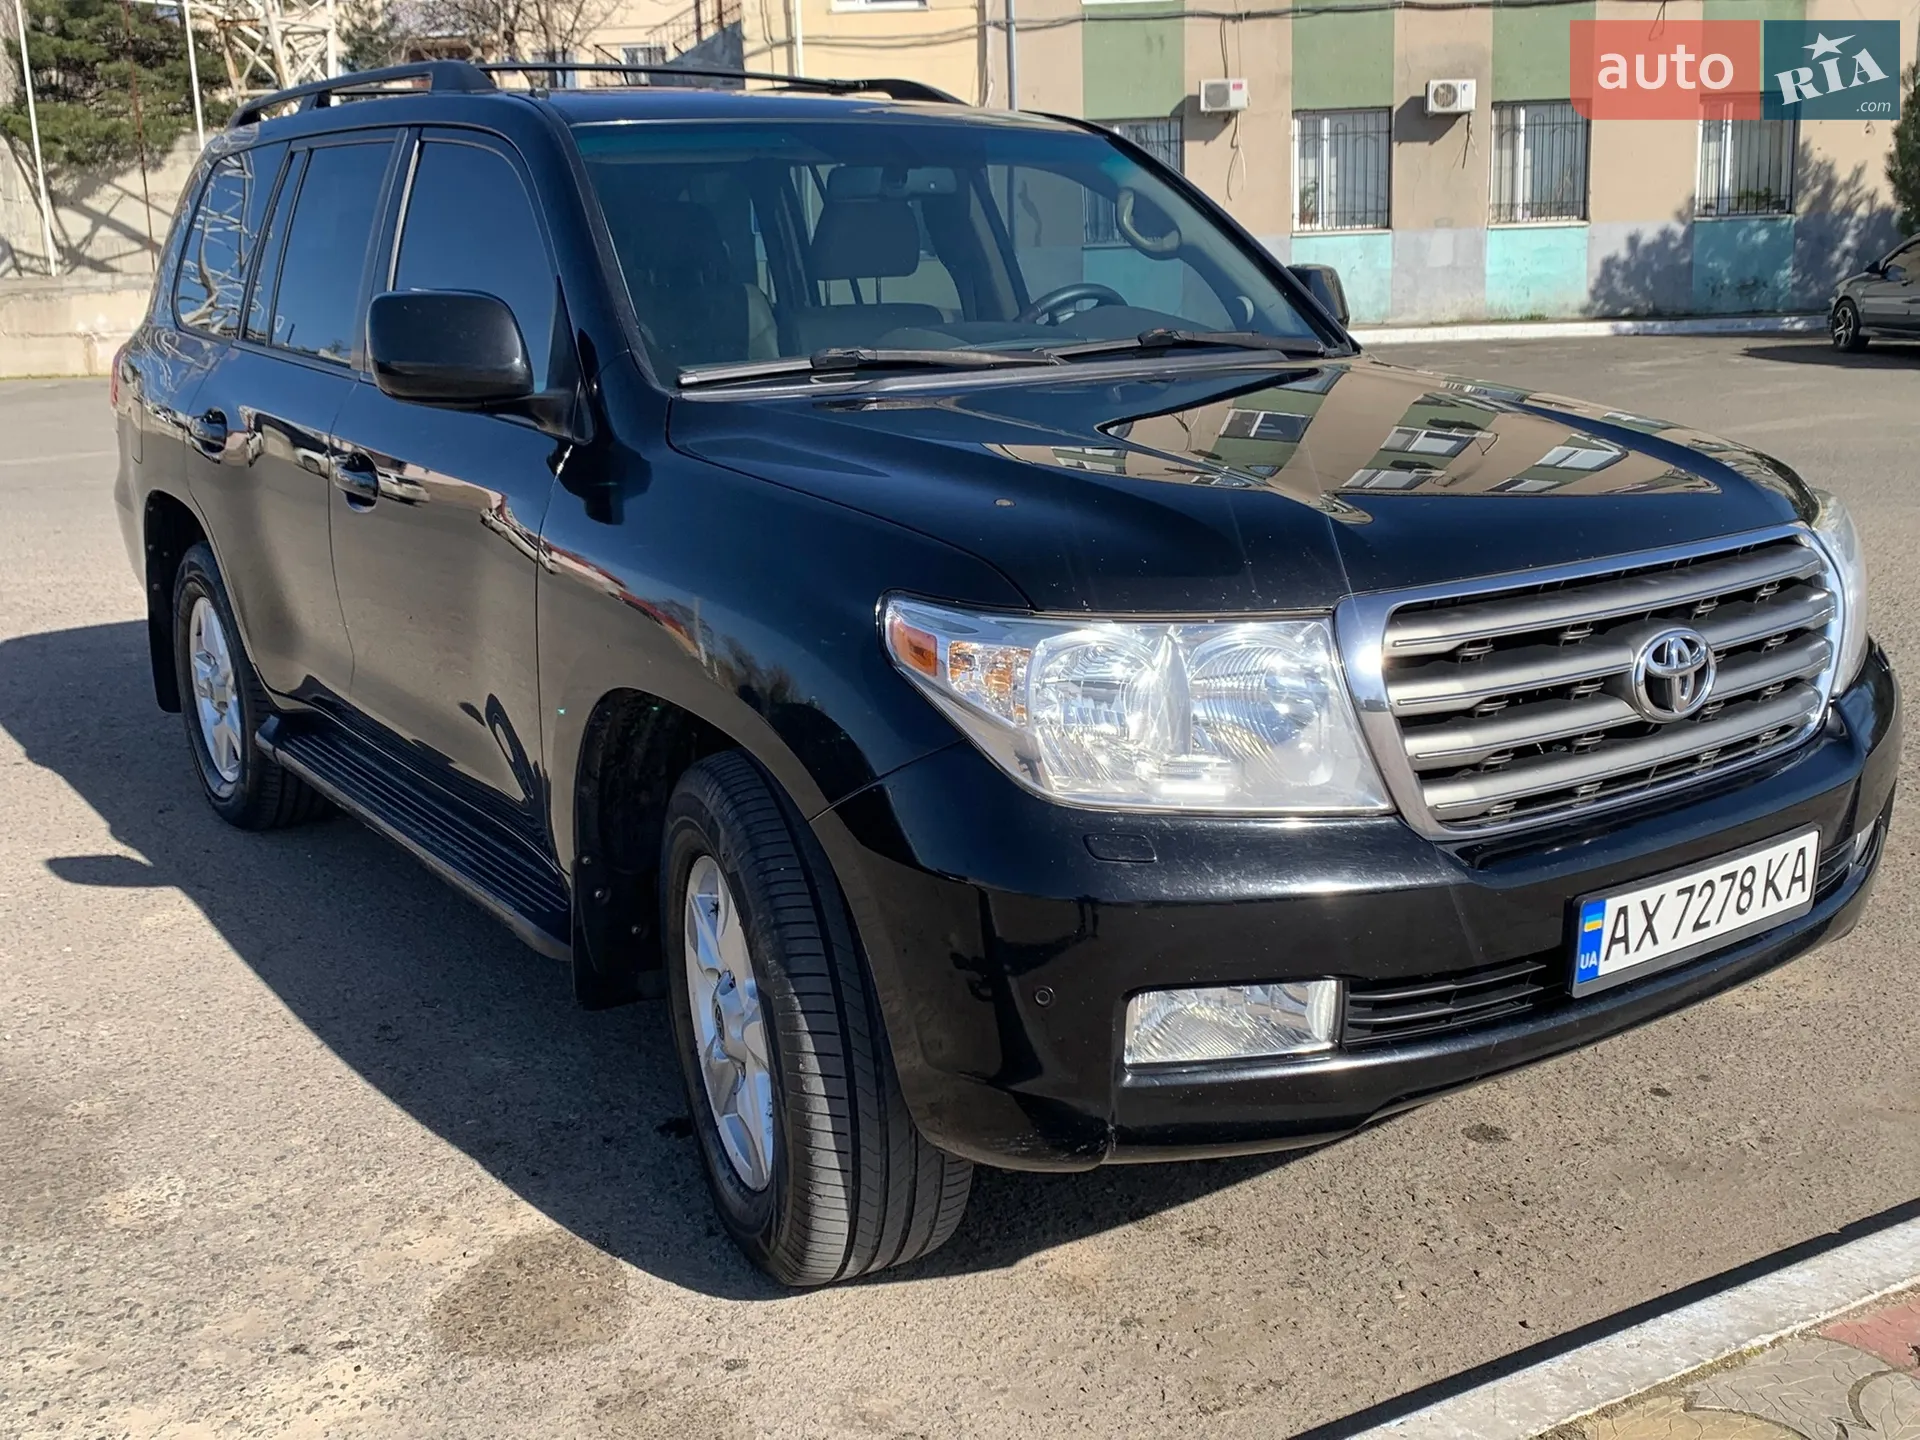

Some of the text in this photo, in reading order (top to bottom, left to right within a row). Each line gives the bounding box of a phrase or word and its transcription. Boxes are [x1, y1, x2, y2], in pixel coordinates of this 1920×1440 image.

[1604, 846, 1807, 961] AX 7278 KA
[1580, 951, 1598, 969] UA
